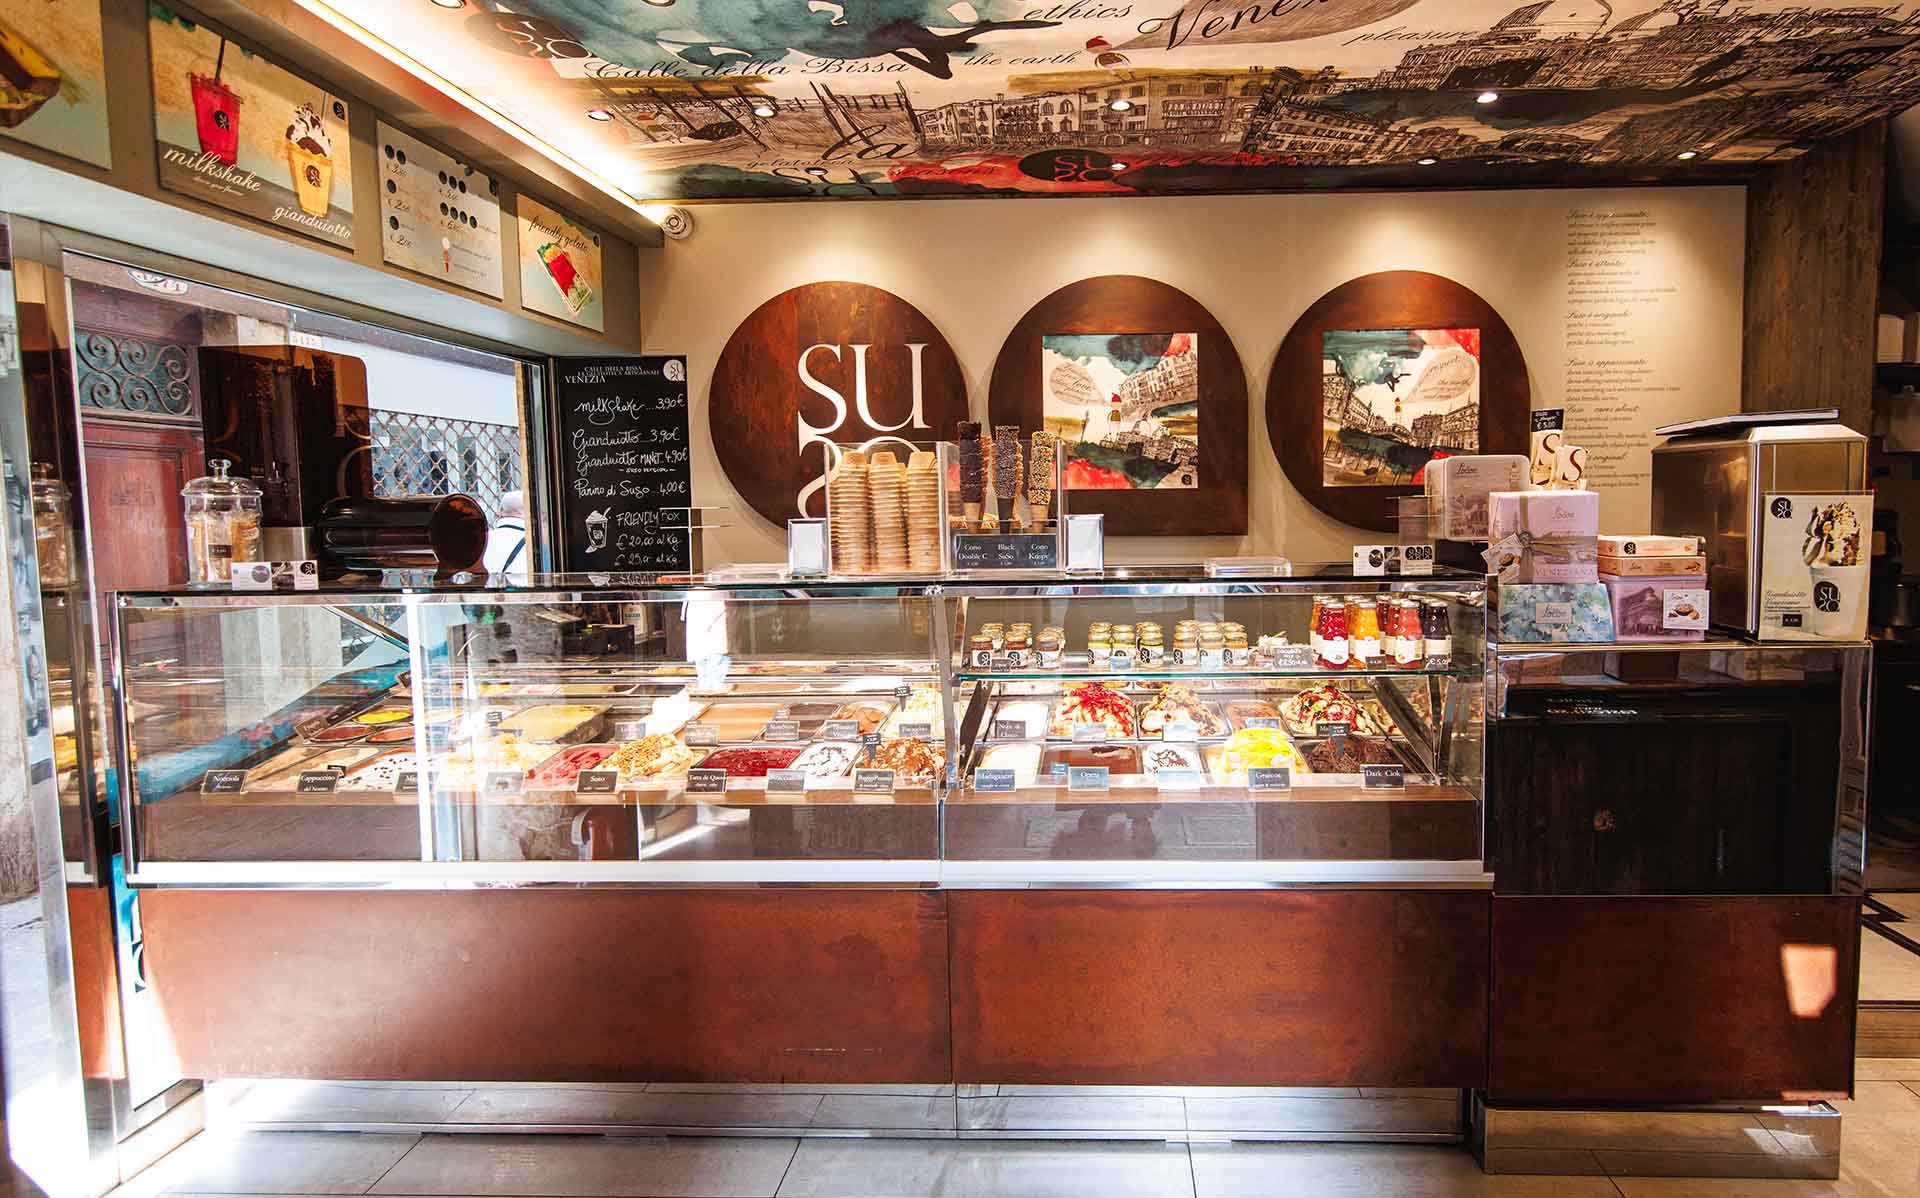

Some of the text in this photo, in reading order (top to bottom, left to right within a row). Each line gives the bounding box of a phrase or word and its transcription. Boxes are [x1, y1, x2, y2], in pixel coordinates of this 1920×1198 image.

[584, 57, 912, 79] Calle della Bissa
[963, 50, 1083, 67] the earth
[162, 147, 262, 192] milkshake
[272, 205, 351, 239] gianduiotto
[564, 375, 606, 384] VENEZIA
[798, 343, 933, 434] SU
[300, 774, 336, 784] Cappuccino
[1365, 769, 1382, 777] Dark
